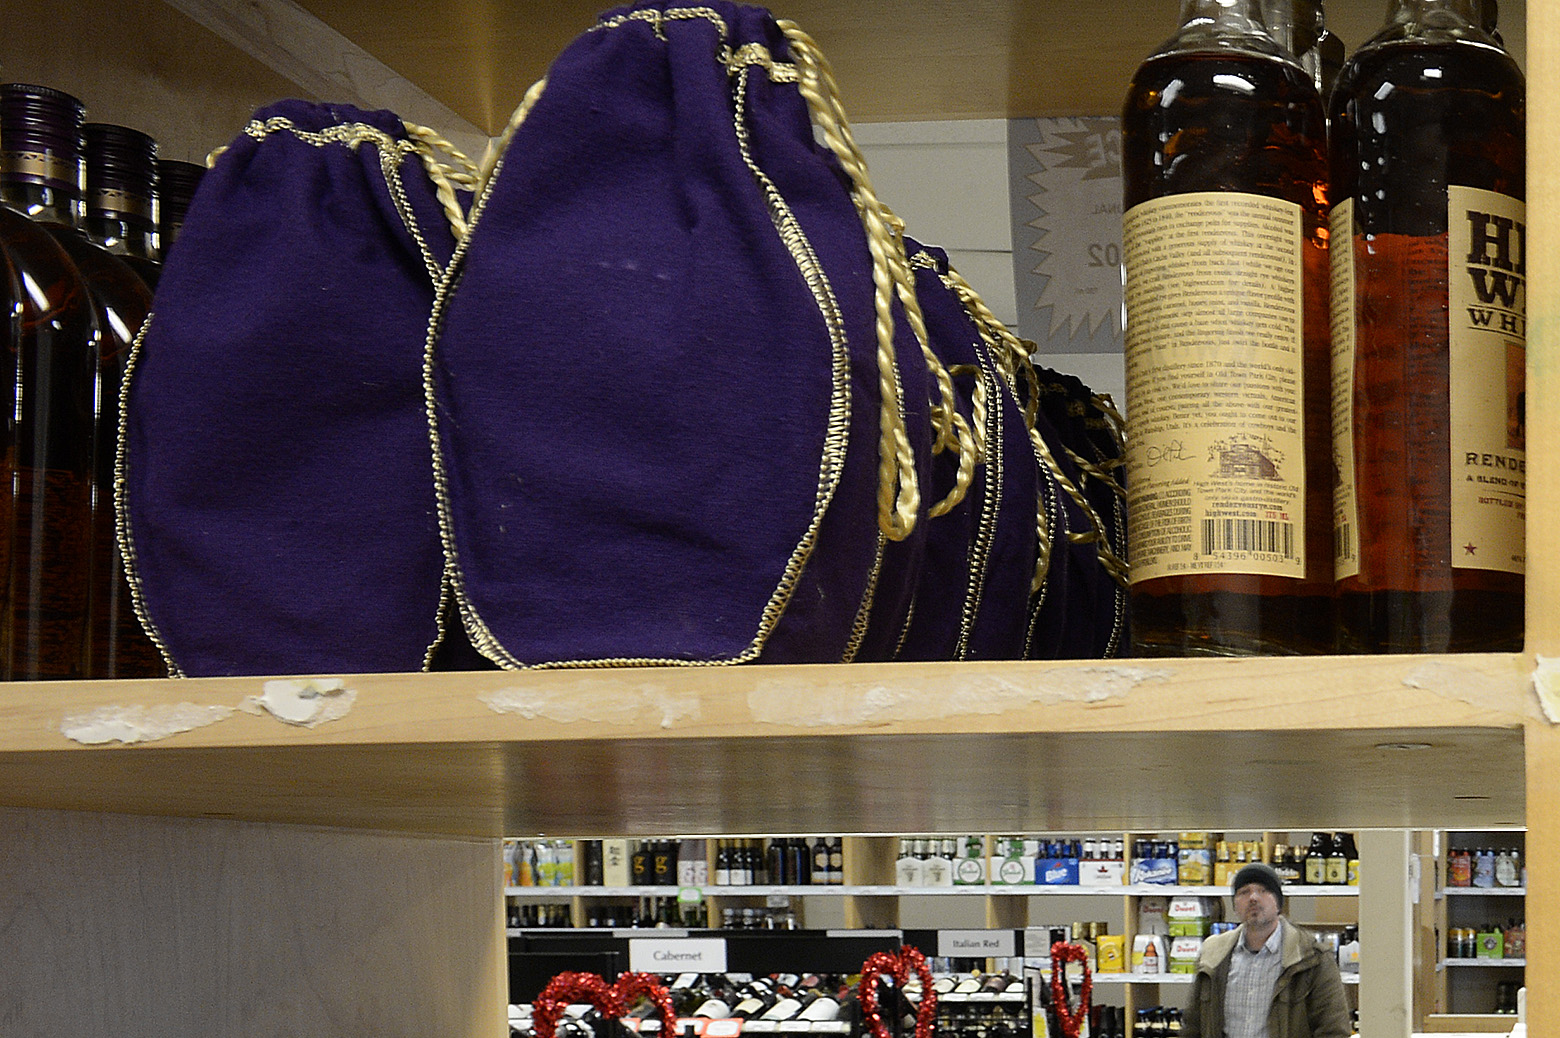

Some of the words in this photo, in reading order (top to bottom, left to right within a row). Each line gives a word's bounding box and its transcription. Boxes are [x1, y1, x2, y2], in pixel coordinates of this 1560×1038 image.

[1205, 510, 1257, 518] highwest.com
[1212, 551, 1246, 560] 54396
[1253, 553, 1284, 563] 00503
[953, 940, 980, 948] Italian
[983, 940, 999, 948] Red
[653, 951, 701, 960] Cabernet
